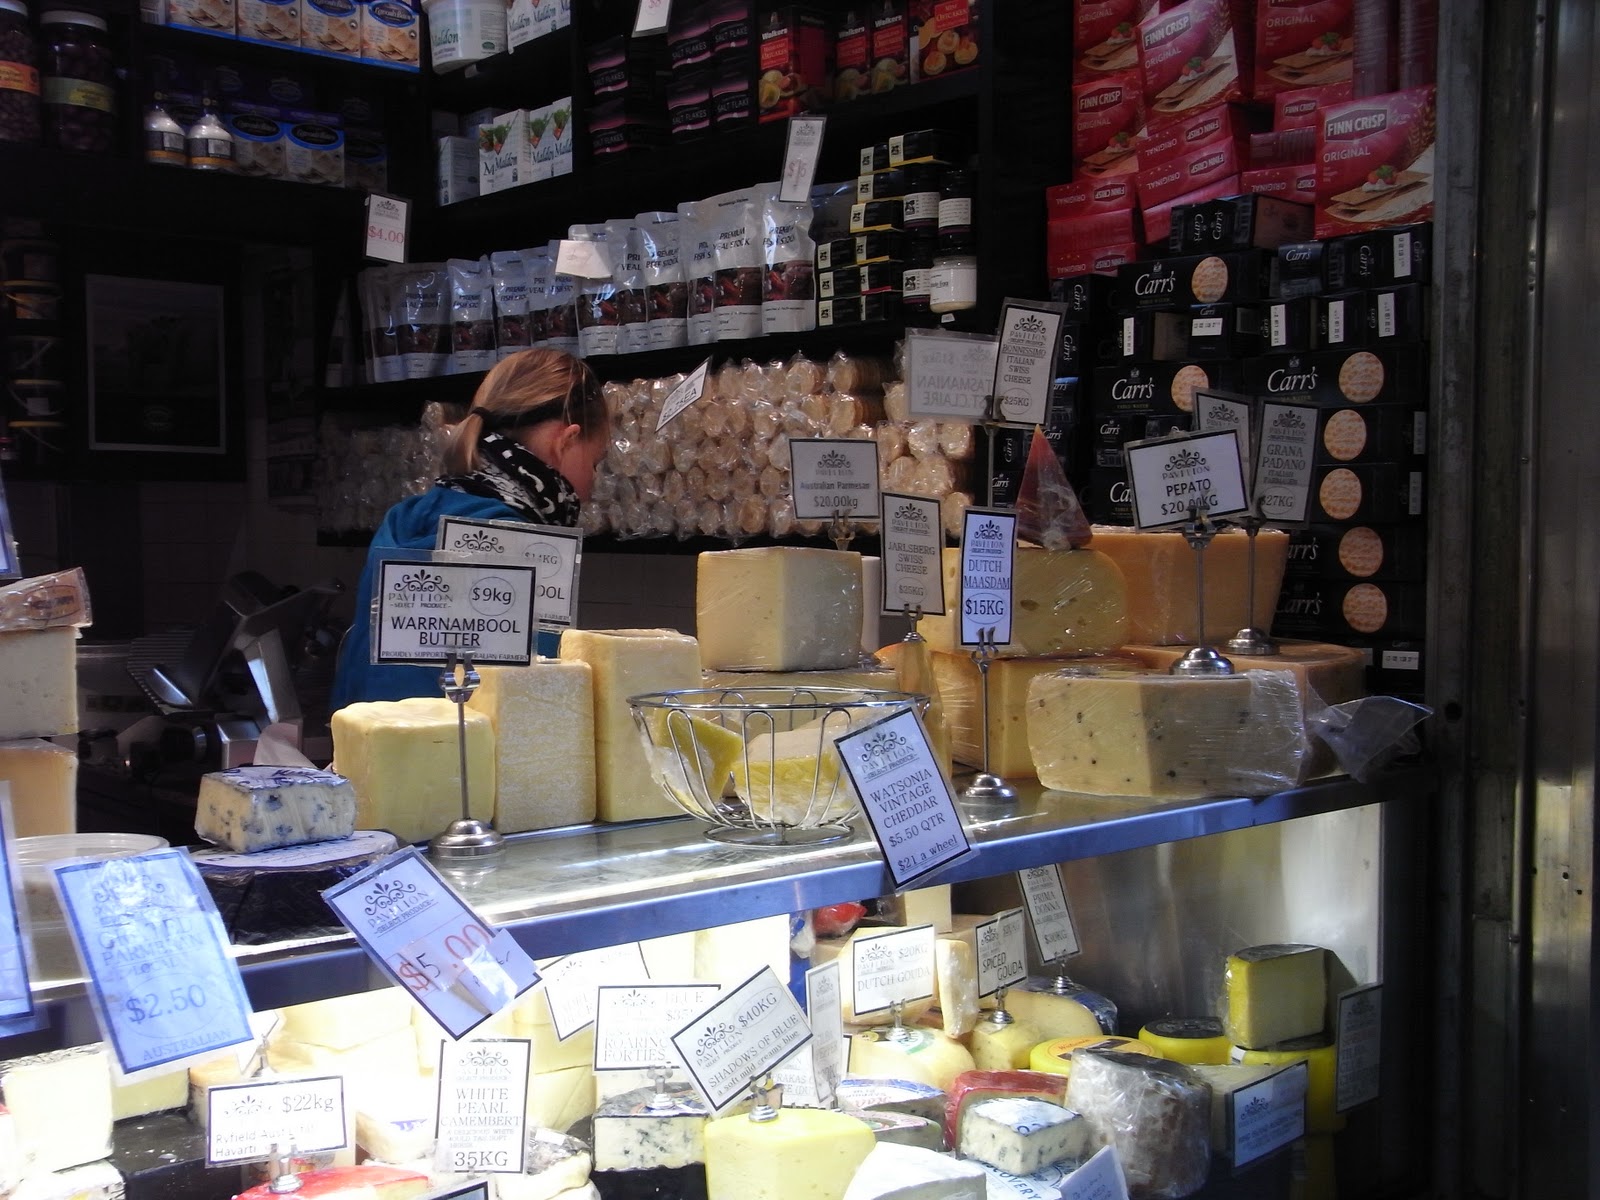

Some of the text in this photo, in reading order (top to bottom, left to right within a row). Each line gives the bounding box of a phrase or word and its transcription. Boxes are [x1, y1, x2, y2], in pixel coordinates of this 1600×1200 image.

[1079, 8, 1113, 24] ORIGINAL
[1266, 14, 1316, 28] ORIGINAL
[1145, 16, 1190, 47] FINN CRISP
[1145, 47, 1182, 69] ORIGINAL
[1080, 91, 1121, 110] FINN CRISP
[1285, 102, 1316, 115] FINN CRISP
[1077, 118, 1111, 132] ORIGINAL
[1327, 114, 1386, 137] FINN CRISP
[1323, 146, 1371, 163] ORIGINAL
[368, 226, 404, 244] $4.00
[719, 227, 745, 240] PREMIUM
[1286, 248, 1312, 262] Carr's
[1134, 270, 1176, 296] Carr's
[1006, 355, 1035, 366] ITALIAN
[1008, 365, 1030, 374] SWISS
[1003, 374, 1032, 385] CHEESE
[1267, 367, 1318, 393] Carr's
[1111, 377, 1154, 401] Carr's
[1267, 444, 1304, 458] GRANA
[1262, 456, 1306, 471] PADANO
[1162, 465, 1210, 480] PAVILION
[801, 480, 870, 490] Australian Parmesan
[1166, 479, 1212, 497] PEPATO
[814, 495, 858, 509] $20.00kg
[887, 540, 936, 556] JARLSBERG
[1287, 537, 1319, 560] arr's
[898, 554, 923, 565] SWISS
[968, 559, 1003, 573] DUTCH
[895, 564, 928, 576] CHEESE
[964, 576, 1010, 590] MAASDAM
[388, 592, 453, 603] PAVILION
[472, 587, 512, 605] $9kg
[965, 599, 1005, 616] $15KG
[391, 616, 521, 634] WARRNAMBOOL
[419, 632, 480, 647] BUTTER
[499, 654, 528, 662] FARMERS
[870, 768, 933, 803] WATSONIA
[879, 782, 932, 813] VINTAGE
[883, 795, 939, 829] CHEDDAR
[889, 812, 946, 848] $5.50 QTR
[897, 834, 958, 872] $21 a wheel
[1033, 892, 1057, 905] PRIMA
[1034, 902, 1061, 915] DONNA
[983, 951, 1006, 973] SPICED
[997, 960, 1024, 981] GOUDA
[858, 967, 931, 992] DUTCH GOUDA
[125, 984, 207, 1024] $2.50
[737, 991, 778, 1028] $40KG
[143, 1029, 232, 1061] AUSTRALIAN
[708, 1014, 800, 1090] SHADOWS OF BLUE
[604, 1048, 666, 1063] FORTIES
[723, 1074, 739, 1093] soft
[739, 1062, 759, 1085] mild
[757, 1045, 783, 1073] creamy
[782, 1030, 800, 1048] blue
[456, 1088, 509, 1100] WHITE
[282, 1093, 334, 1113] $22kg
[457, 1102, 509, 1114] PEARL
[440, 1116, 522, 1127] CAMEMBERT
[216, 1145, 256, 1158] Havarti
[454, 1151, 508, 1167] 35KG
